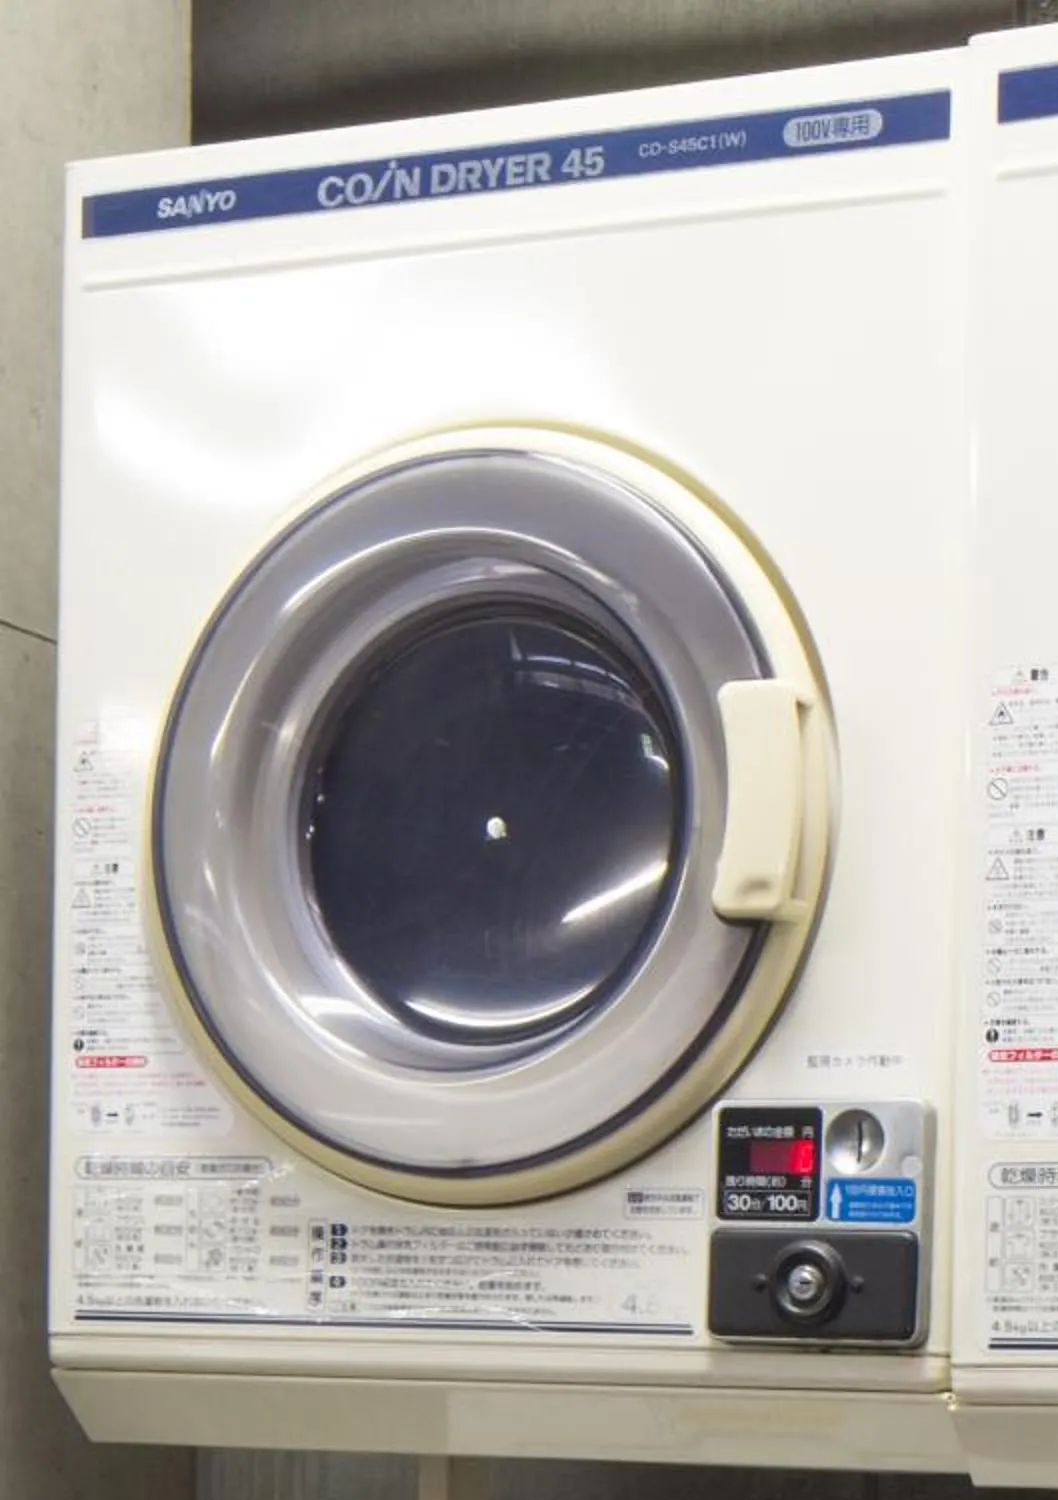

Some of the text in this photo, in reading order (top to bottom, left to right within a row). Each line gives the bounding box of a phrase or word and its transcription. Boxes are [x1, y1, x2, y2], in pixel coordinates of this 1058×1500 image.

[157, 188, 237, 219] SANYO
[429, 150, 552, 196] DRYER
[561, 145, 606, 179] 45
